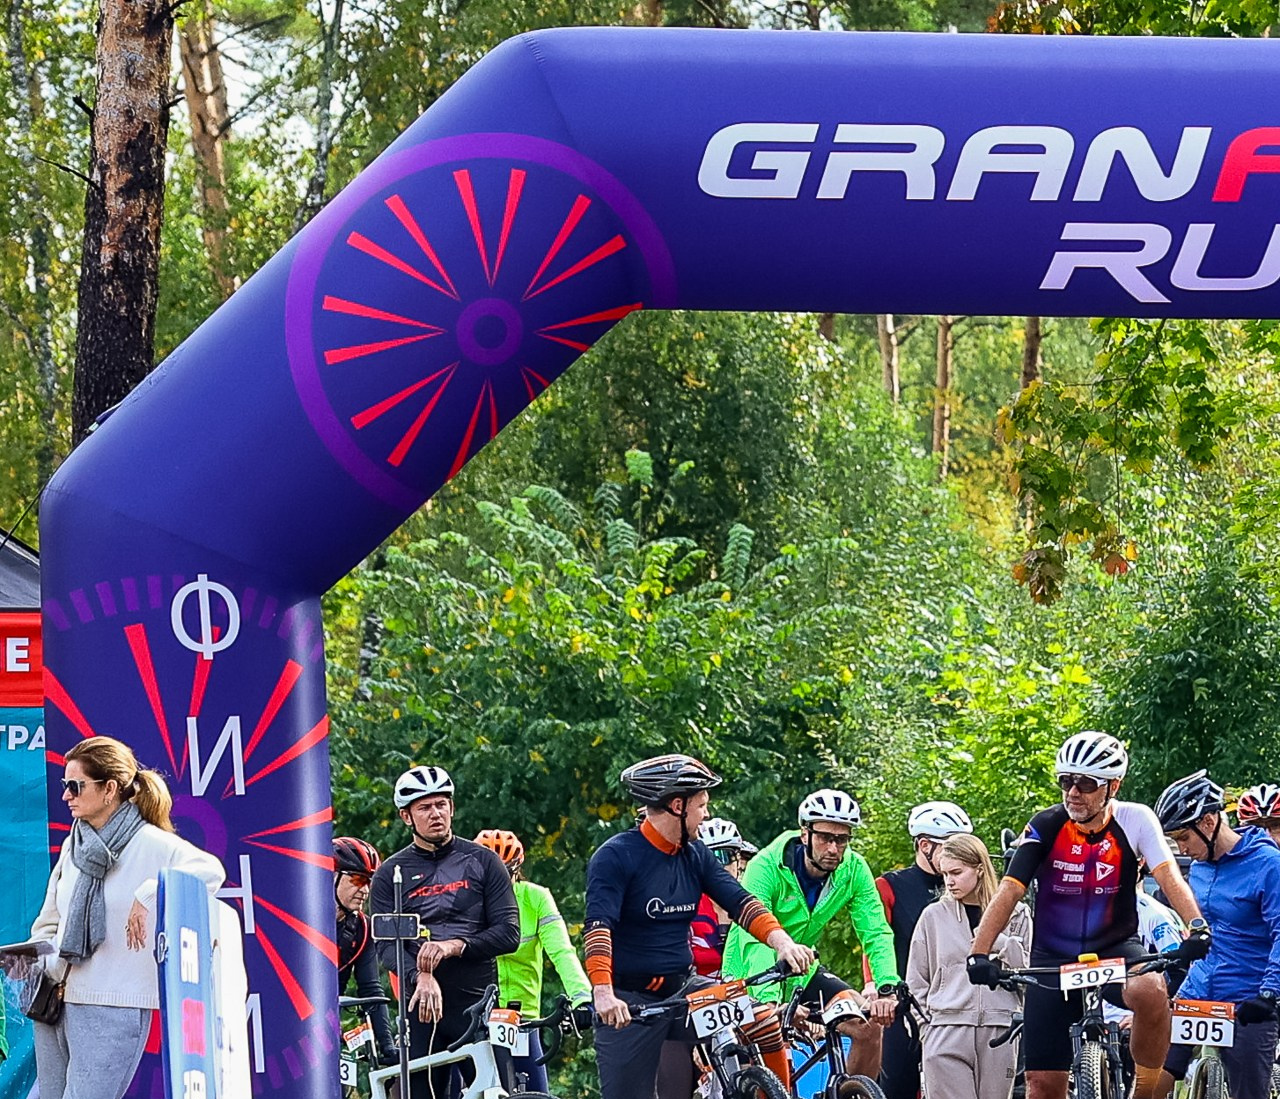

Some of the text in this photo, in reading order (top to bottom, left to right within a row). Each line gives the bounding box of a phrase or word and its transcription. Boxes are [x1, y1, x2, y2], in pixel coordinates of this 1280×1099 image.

[1071, 968, 1115, 986] 309
[702, 1001, 745, 1031] 306
[831, 1000, 857, 1015] 31
[497, 1024, 518, 1048] 30
[1180, 1019, 1224, 1043] 305
